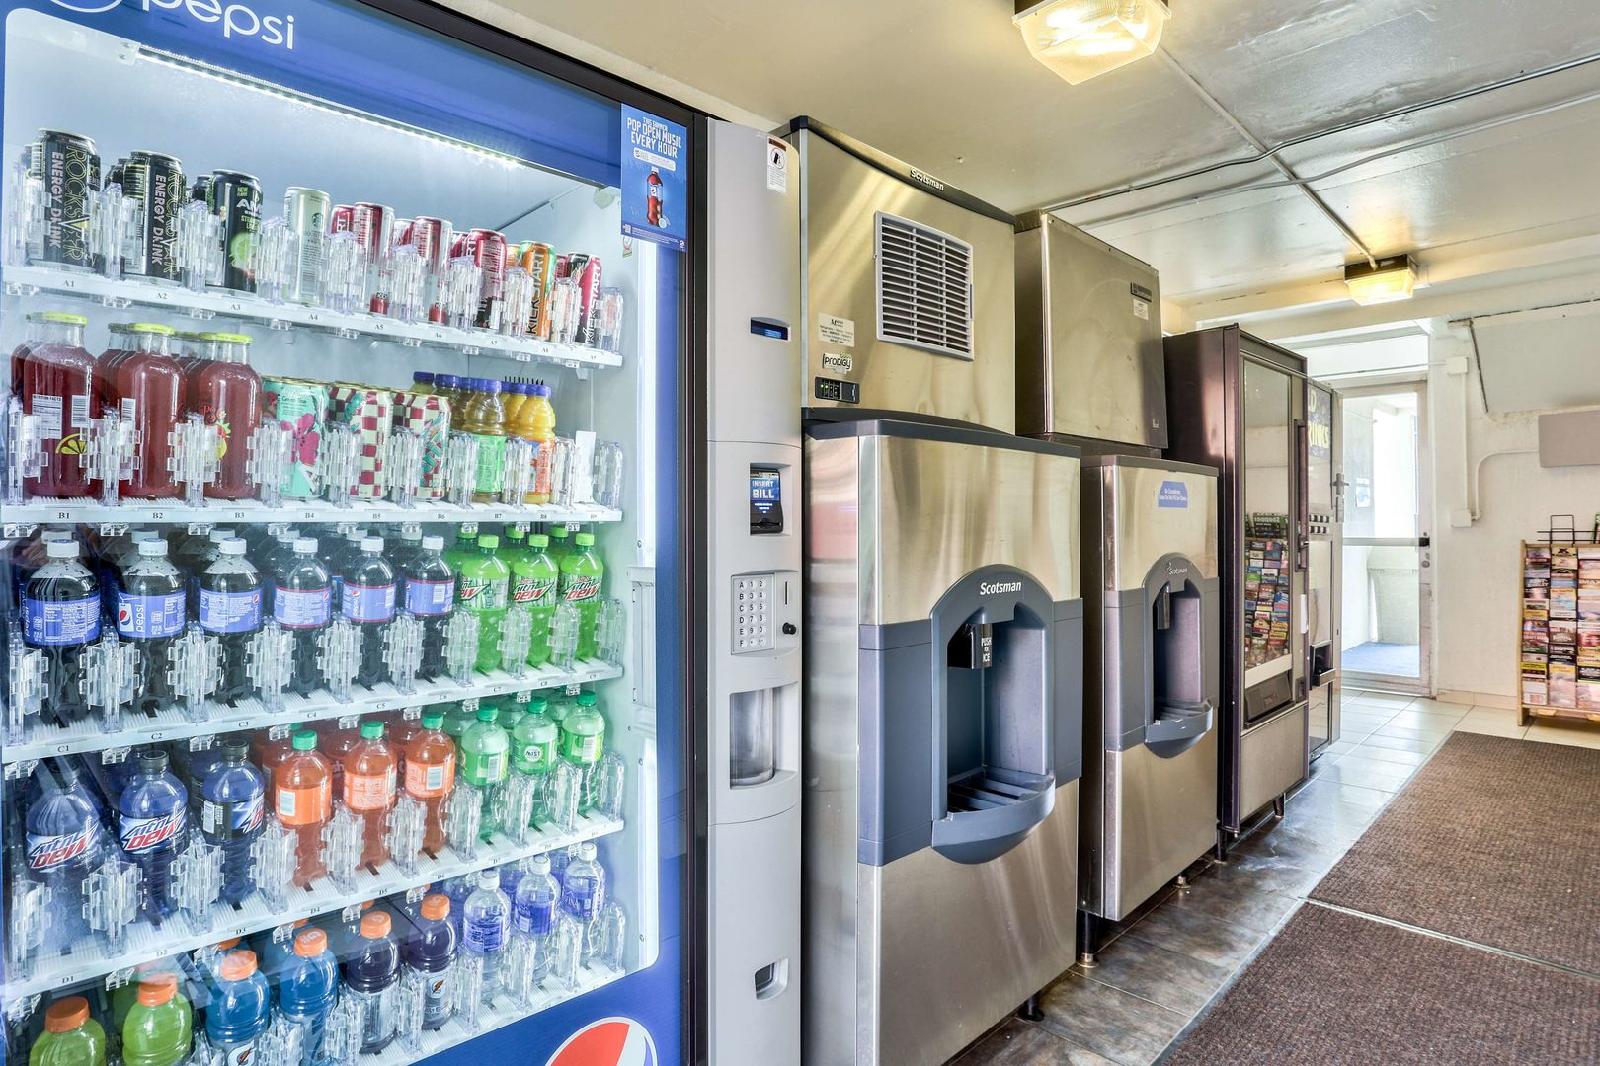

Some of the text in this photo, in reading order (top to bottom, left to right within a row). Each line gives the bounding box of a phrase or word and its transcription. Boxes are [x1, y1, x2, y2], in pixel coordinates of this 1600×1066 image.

[627, 117, 641, 132] POP
[643, 123, 661, 141] OPEN
[631, 131, 678, 158] EVERY HOUR
[52, 151, 63, 204] ENERGY
[911, 168, 944, 191] Scotsman
[153, 174, 166, 223] ENERGY
[752, 489, 774, 499] BILL
[980, 582, 1022, 595] Scotsman
[135, 602, 146, 633] pepsi
[740, 616, 744, 624] D
[982, 653, 991, 662] ICE
[151, 732, 163, 740] C2
[57, 745, 70, 753] C1
[61, 975, 74, 983] D1
